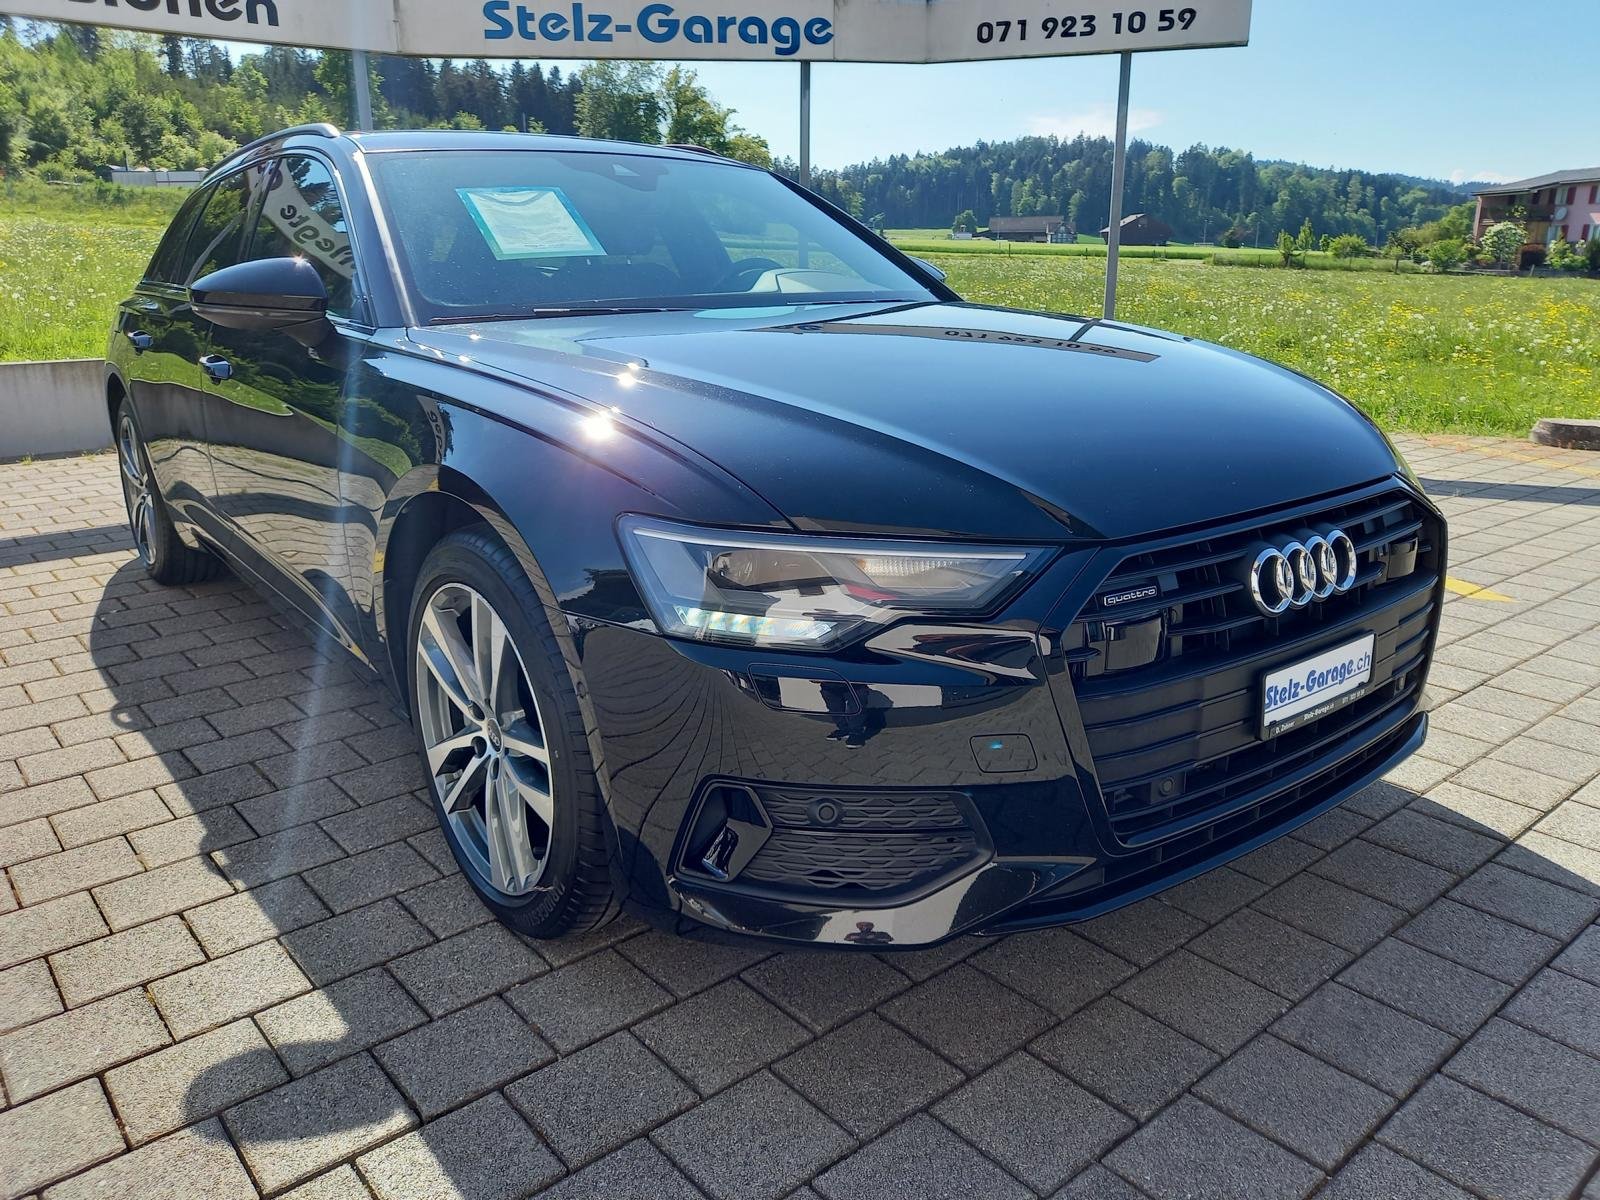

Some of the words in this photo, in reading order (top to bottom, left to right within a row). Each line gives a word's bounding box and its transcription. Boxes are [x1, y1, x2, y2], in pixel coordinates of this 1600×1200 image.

[483, 1, 834, 55] Stelz-Garage
[977, 20, 1027, 43] 071
[1041, 15, 1097, 39] 923
[1112, 11, 1147, 34] 10
[1157, 8, 1197, 31] 59
[1107, 588, 1156, 604] quattro
[1264, 652, 1371, 710] Stelz-Garage.ch
